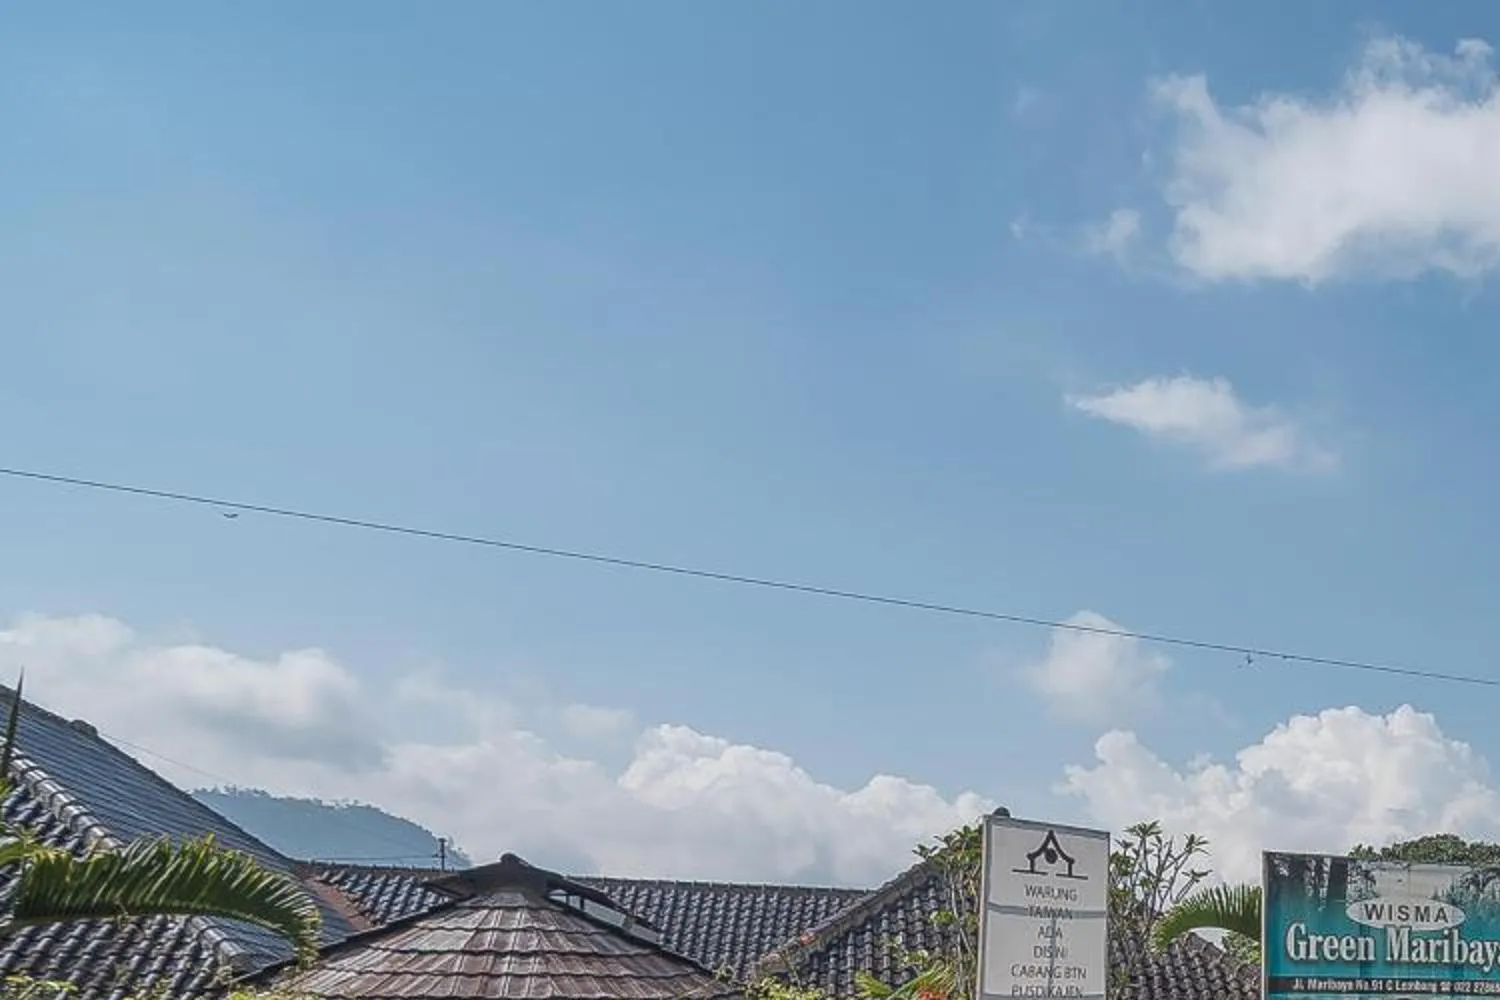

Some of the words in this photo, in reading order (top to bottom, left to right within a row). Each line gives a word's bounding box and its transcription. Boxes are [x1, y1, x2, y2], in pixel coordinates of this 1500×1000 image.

[1023, 884, 1078, 901] WARUNG
[1363, 903, 1449, 924] WISMA
[1037, 925, 1063, 939] ADA
[1286, 922, 1376, 962] Green
[1010, 963, 1062, 979] CABANG
[1064, 965, 1087, 981] BTN
